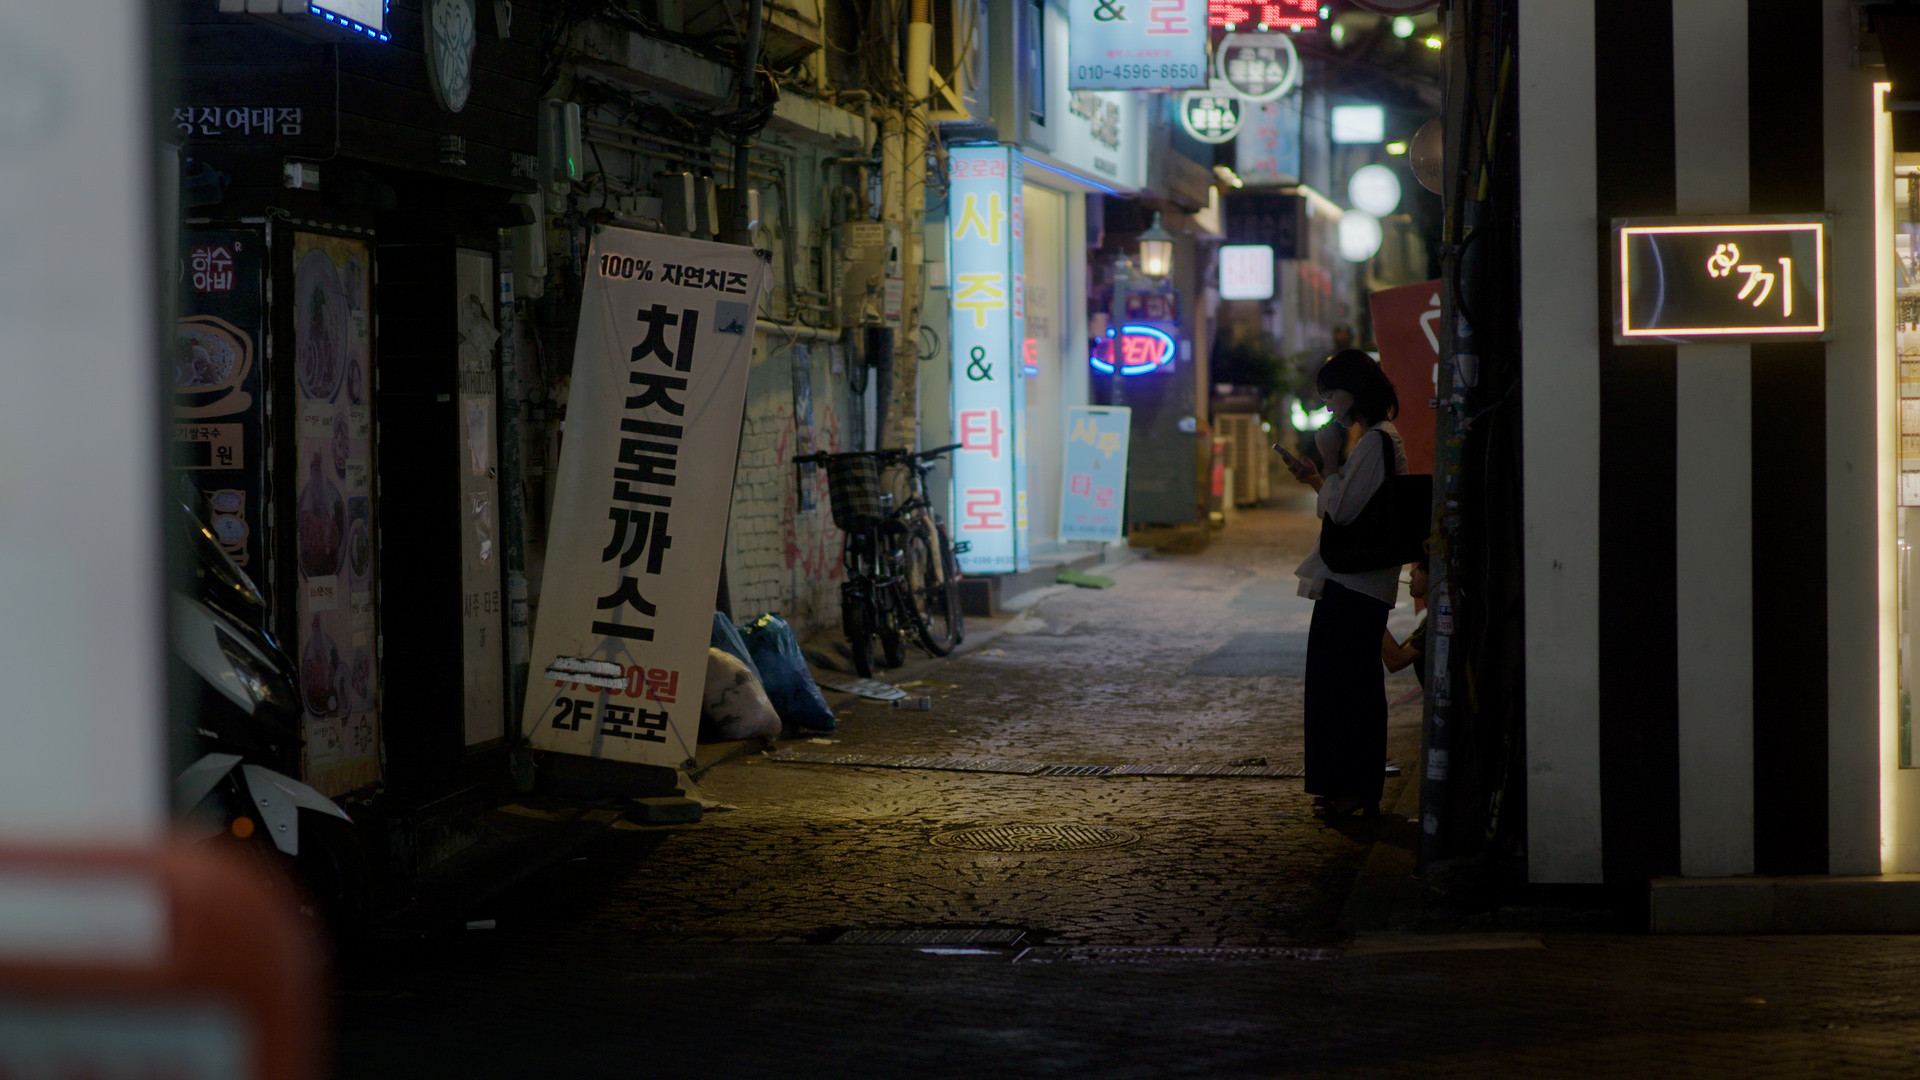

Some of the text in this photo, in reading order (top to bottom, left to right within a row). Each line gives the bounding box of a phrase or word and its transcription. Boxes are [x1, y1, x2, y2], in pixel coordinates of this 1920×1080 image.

[1078, 64, 1198, 80] 010-4596-8650
[952, 159, 1007, 179] 오로라
[600, 254, 748, 294] 100% 자연치즈
[955, 194, 1004, 327] 사주
[193, 270, 232, 292] 아비
[967, 346, 992, 381] &
[216, 446, 232, 465] 원
[592, 303, 699, 642] 치즈돈까스
[960, 410, 1006, 529] 타로
[552, 697, 669, 743] 2F 포보
